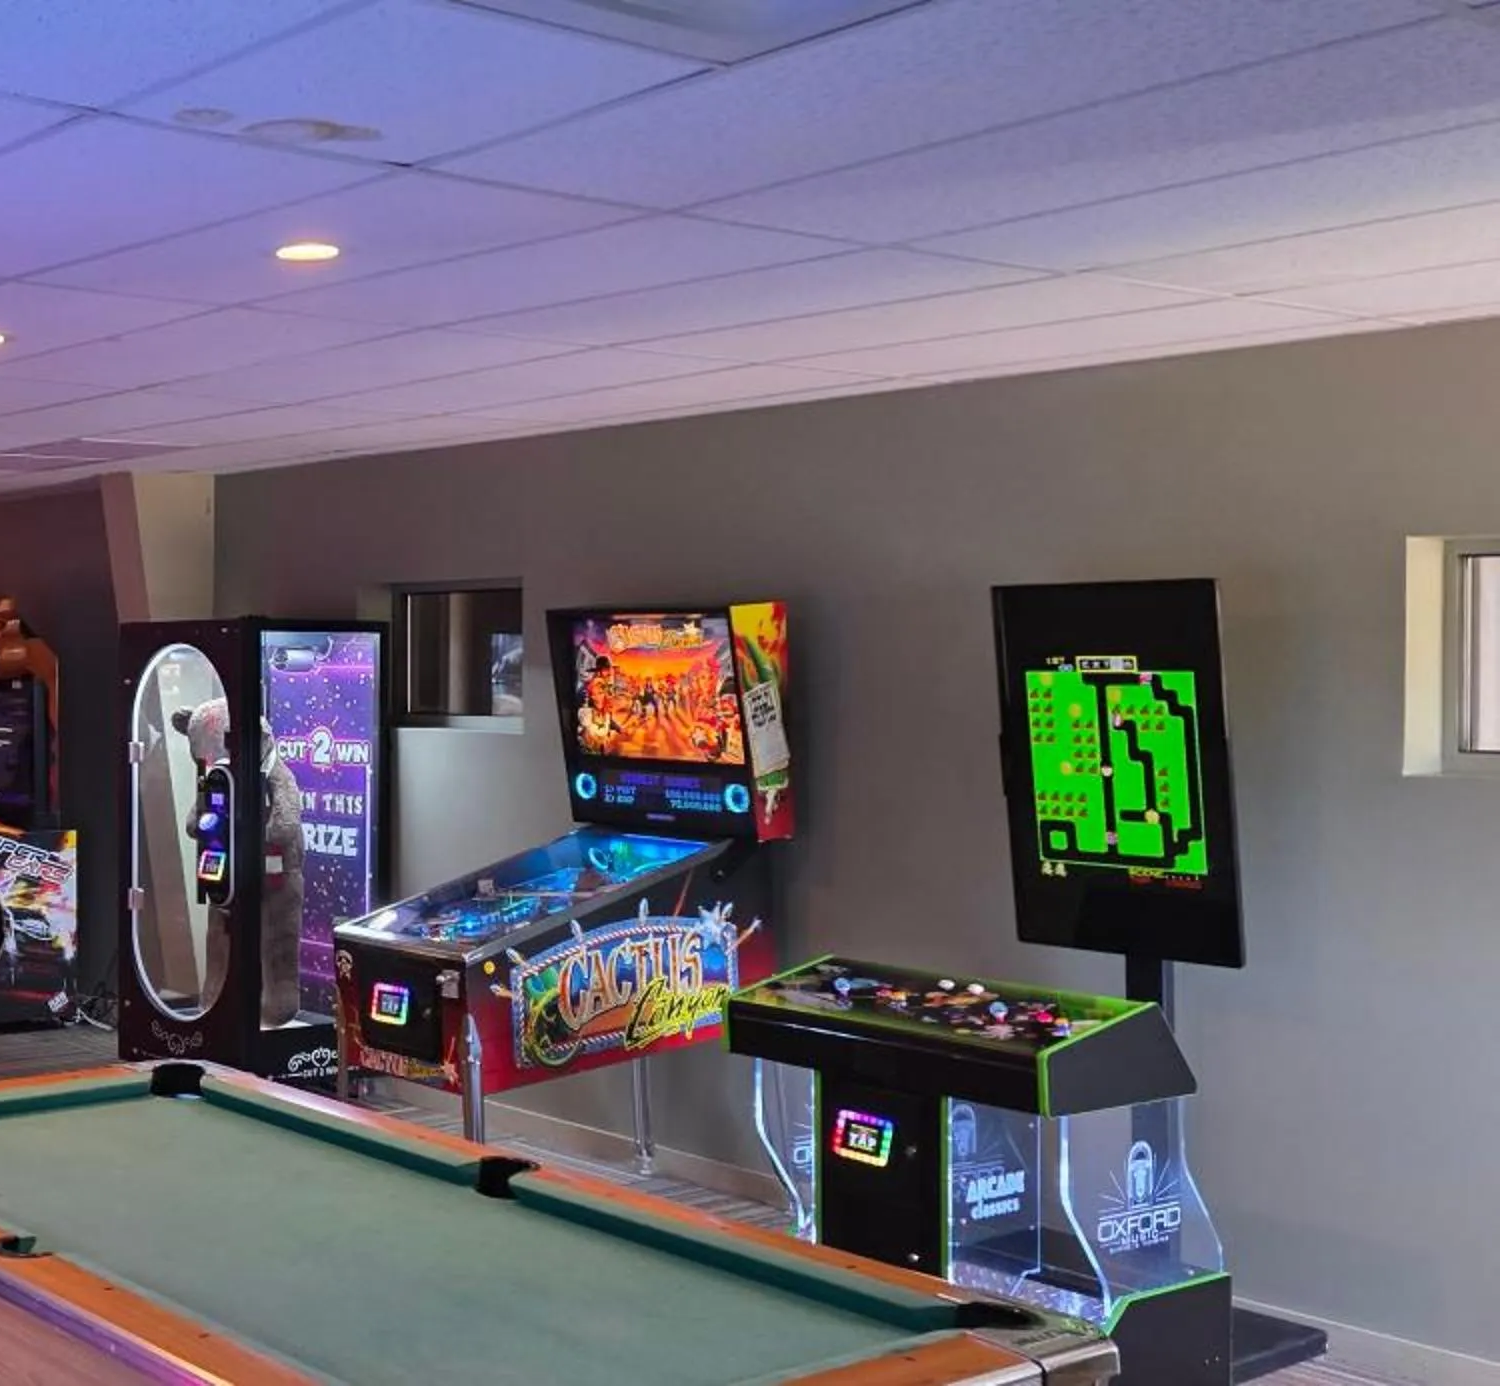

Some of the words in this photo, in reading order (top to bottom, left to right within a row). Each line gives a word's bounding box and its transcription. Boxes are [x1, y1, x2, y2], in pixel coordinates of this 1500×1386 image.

[277, 740, 306, 759] CUT
[312, 731, 331, 762] 2
[322, 793, 363, 815] THIS
[301, 822, 358, 857] RIZE
[558, 931, 703, 1032] CACTUS
[624, 976, 730, 1051] Canyon
[848, 1131, 878, 1152] TAP
[965, 1170, 1025, 1203] ARCADE
[1097, 1206, 1182, 1243] OXFORD
